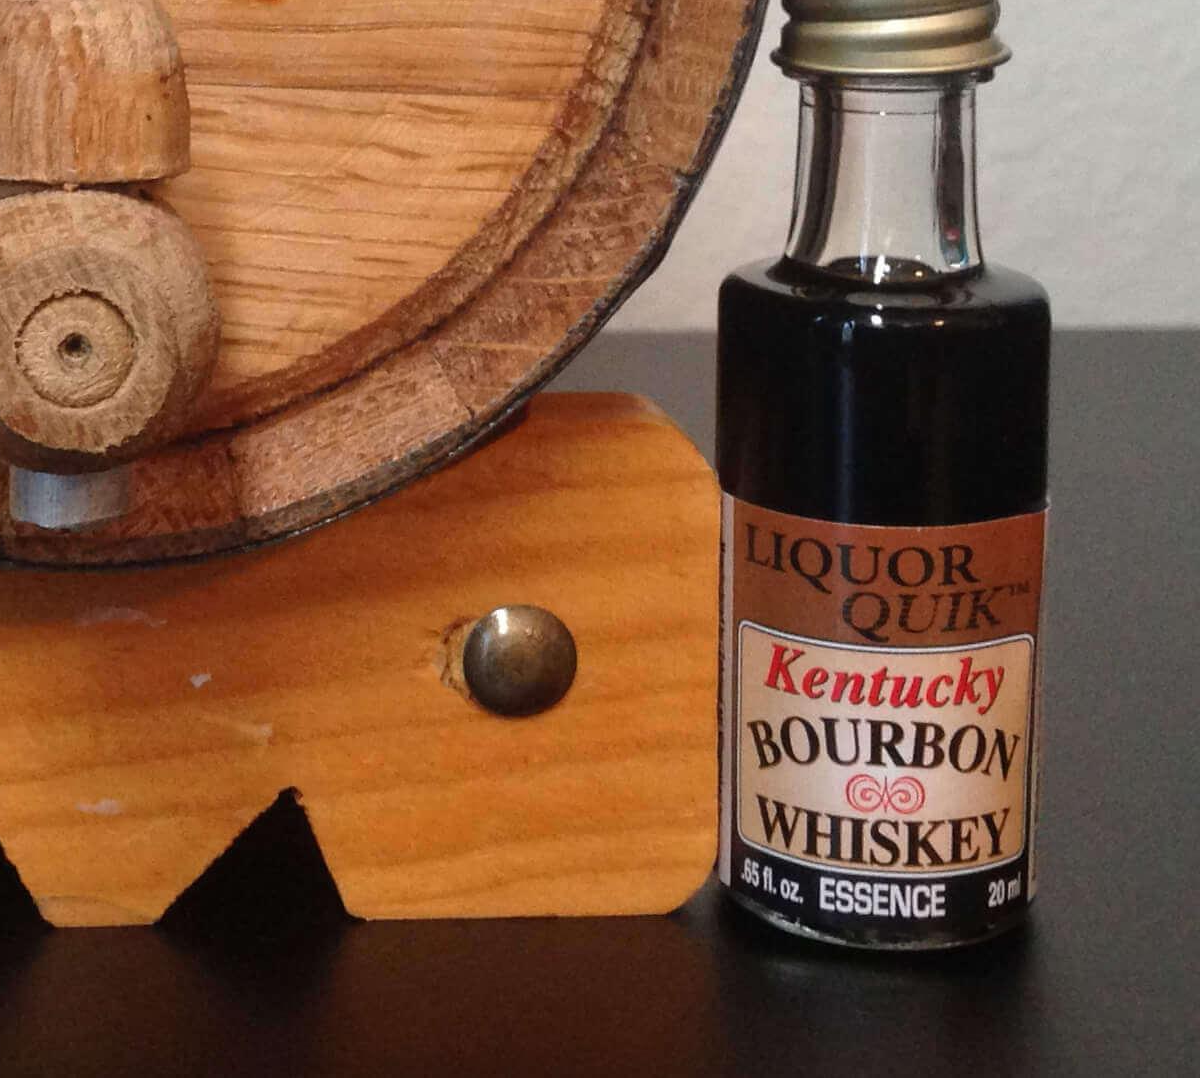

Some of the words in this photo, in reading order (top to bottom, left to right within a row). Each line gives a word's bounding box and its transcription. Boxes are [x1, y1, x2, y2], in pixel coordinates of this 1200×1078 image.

[745, 522, 980, 594] LIQUOR
[764, 643, 1006, 715] Kentucky
[747, 716, 1021, 782] BOURBON
[756, 793, 1011, 868] WHISKEY
[780, 878, 804, 904] oz.
[819, 876, 947, 919] ESSENCE
[987, 879, 1005, 908] 20
[1006, 872, 1022, 899] ml
